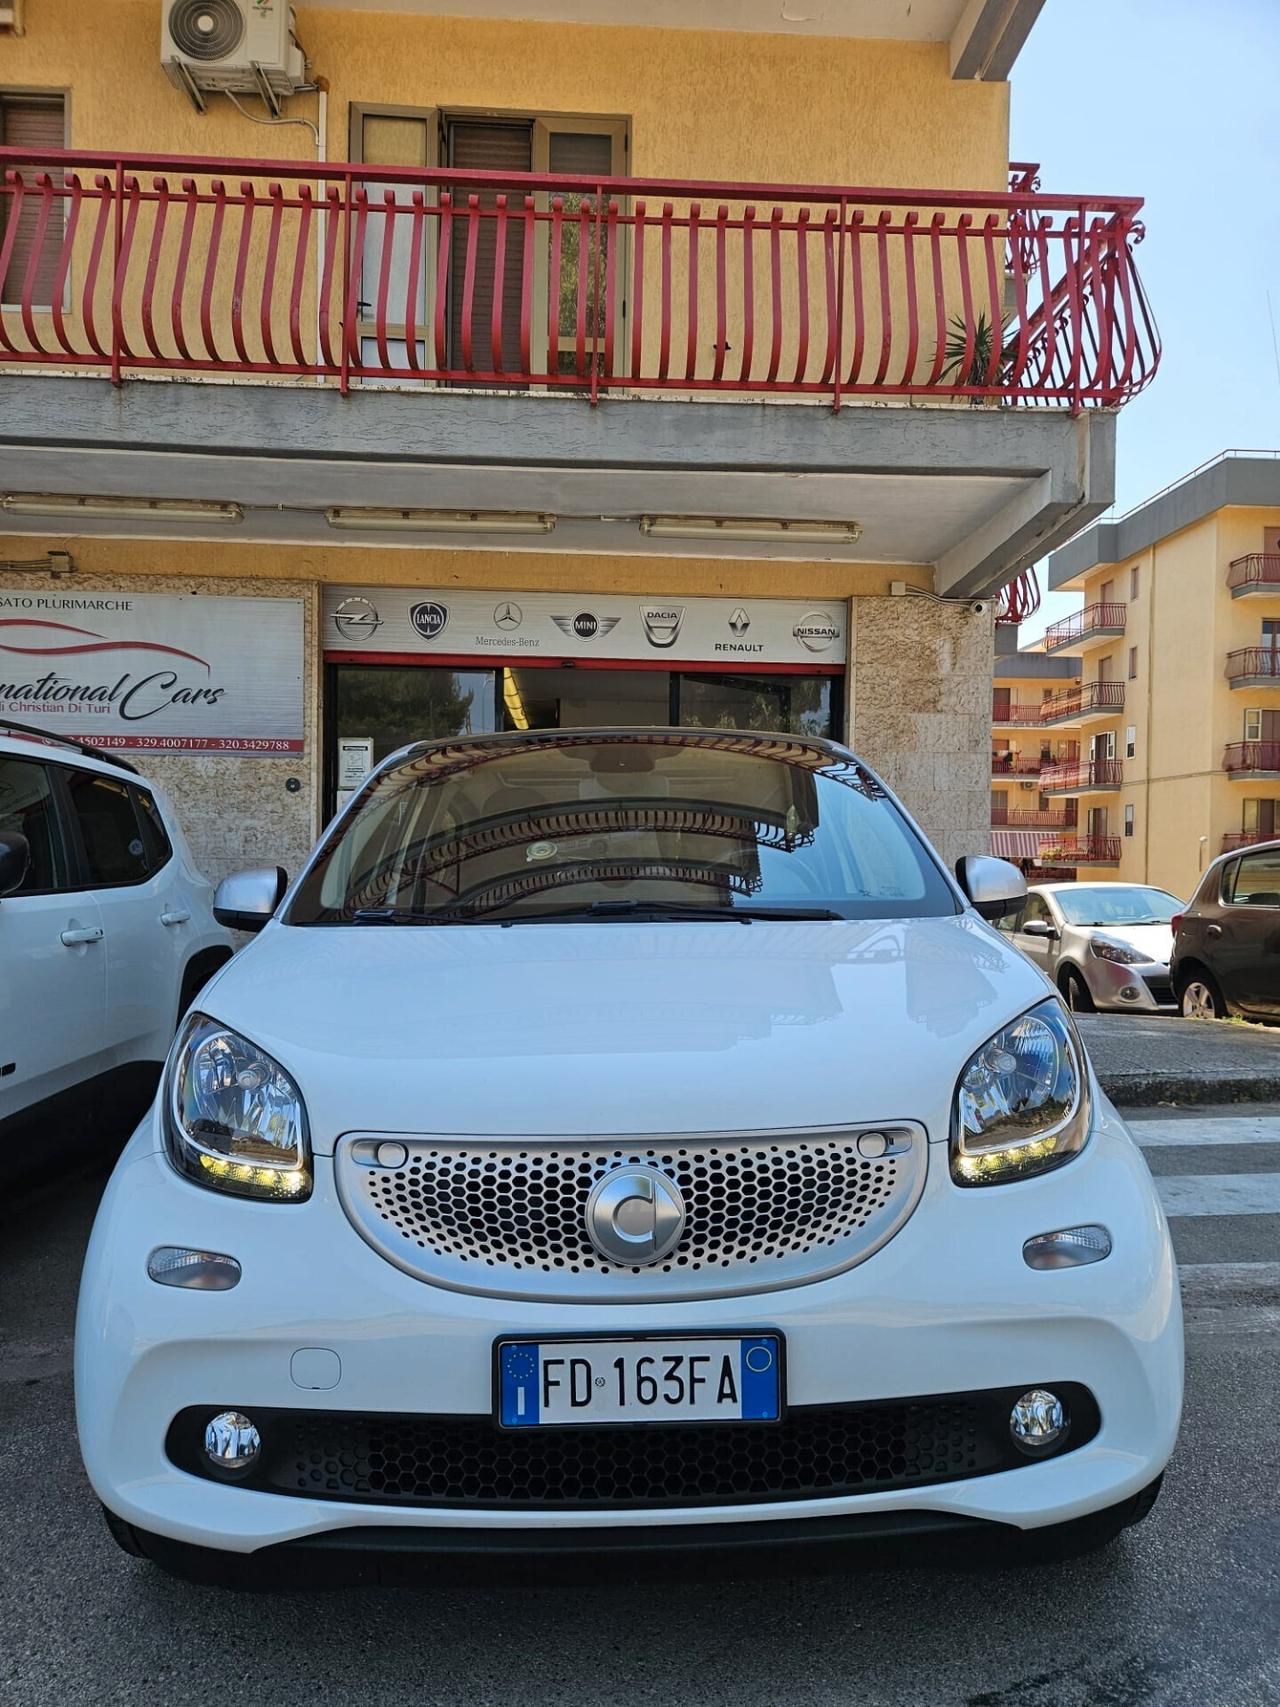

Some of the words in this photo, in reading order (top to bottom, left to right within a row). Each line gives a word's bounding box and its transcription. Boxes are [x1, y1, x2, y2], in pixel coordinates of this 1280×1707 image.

[37, 598, 134, 611] PLURIMARCHE
[416, 613, 441, 625] LANCIA
[646, 611, 678, 619] DACIA
[574, 620, 597, 630] MINI
[797, 627, 836, 636] NISSAN
[475, 636, 540, 647] Mercedes-Benz
[714, 643, 765, 652] RENAULT
[119, 670, 226, 721] Cars
[9, 701, 64, 713] Christian
[68, 702, 82, 713] Di
[85, 702, 111, 714] Turi
[136, 738, 209, 749] 329.4007177
[218, 739, 290, 751] 320.3429788
[543, 1358, 592, 1408] FD
[613, 1354, 738, 1407] 163FA
